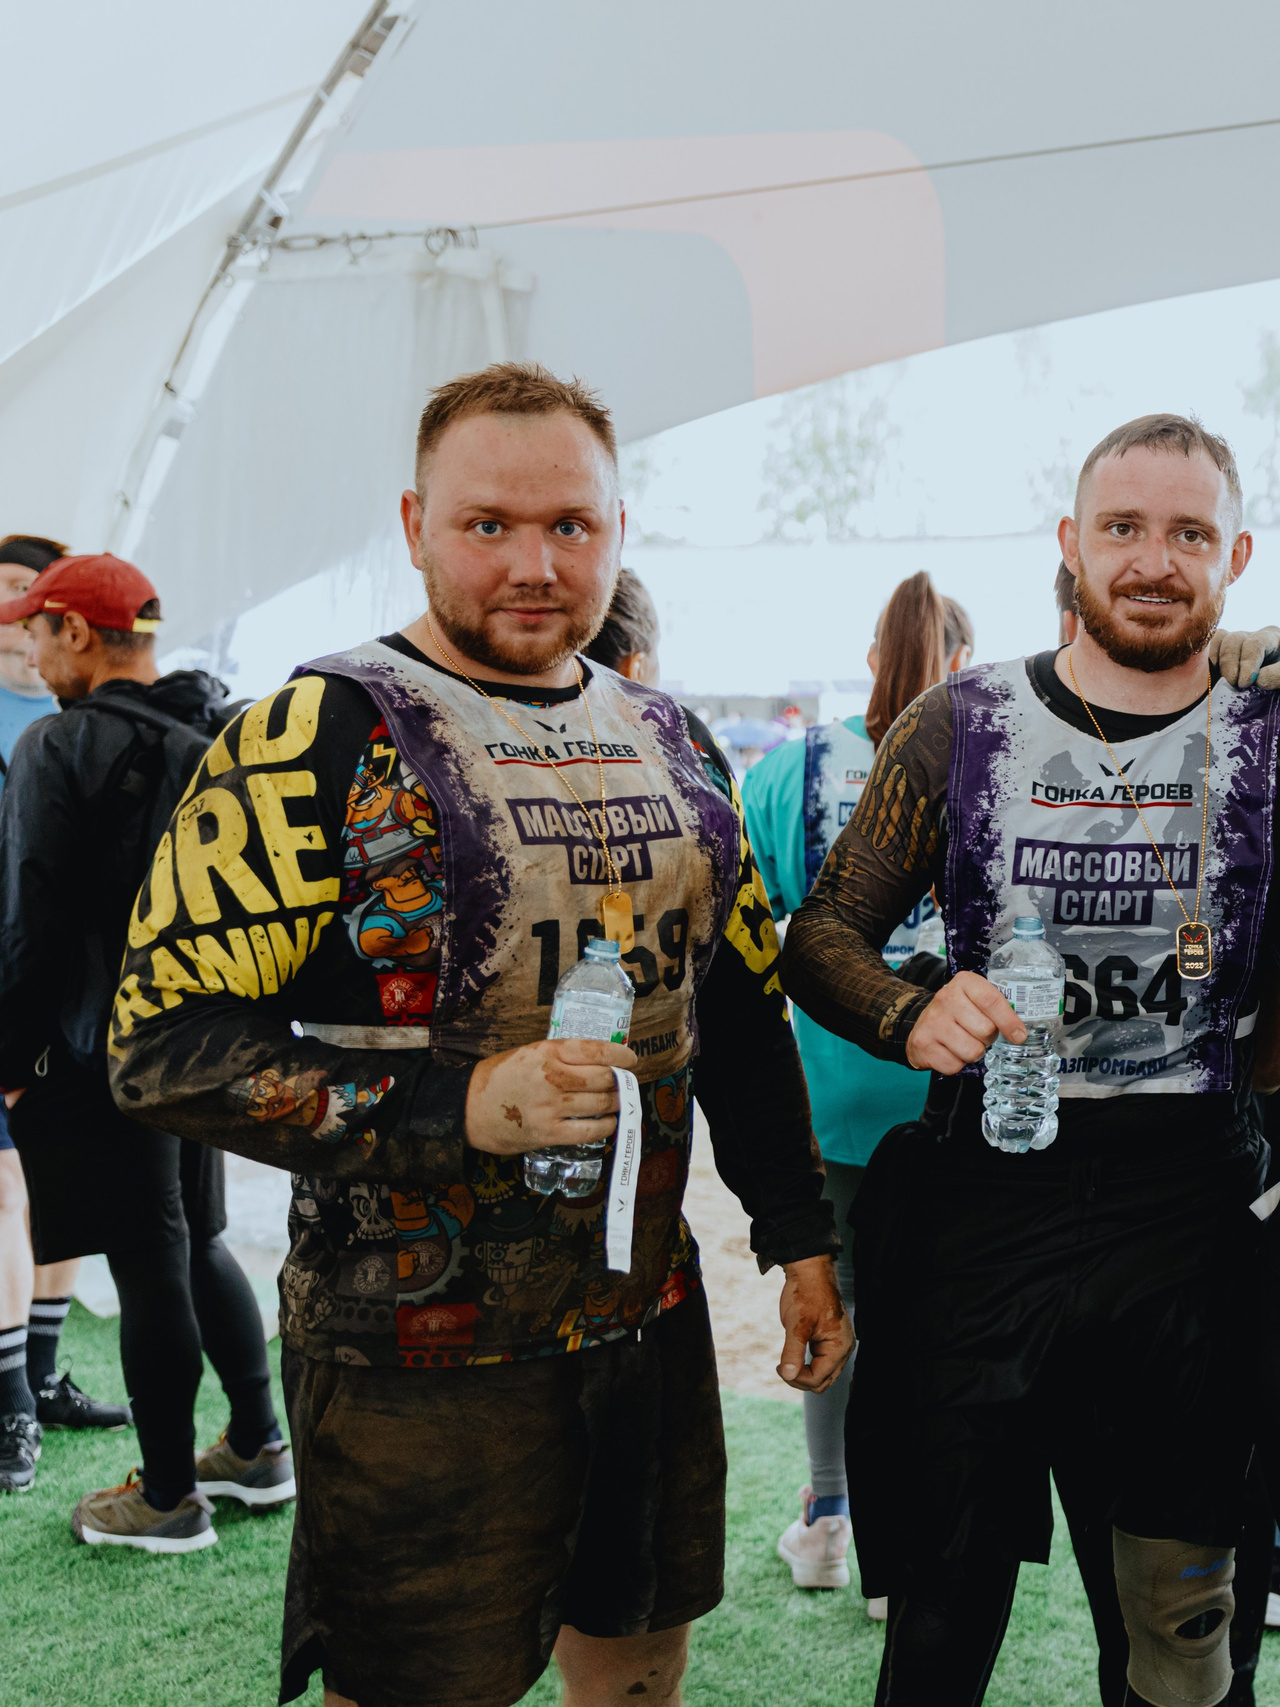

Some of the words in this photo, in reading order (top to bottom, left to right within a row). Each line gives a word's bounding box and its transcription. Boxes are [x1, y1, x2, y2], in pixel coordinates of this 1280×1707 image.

[484, 742, 560, 762] ГОНКА
[563, 740, 638, 758] ГЕРОЕВ
[1031, 781, 1104, 802] ГОНКА
[1110, 783, 1193, 801] ГЕРОЕВ
[516, 795, 676, 840] МАССОВЫЙ
[572, 842, 644, 880] СТАРТ
[1019, 840, 1191, 883] МАССОВЫЙ
[1060, 889, 1148, 921] СТАРТ
[629, 1030, 679, 1057] ОМБАНК
[1057, 1057, 1168, 1076] АЗПРОМБАНК
[620, 1160, 630, 1186] ГОНКА
[625, 1128, 634, 1159] ГЕРОЕВ
